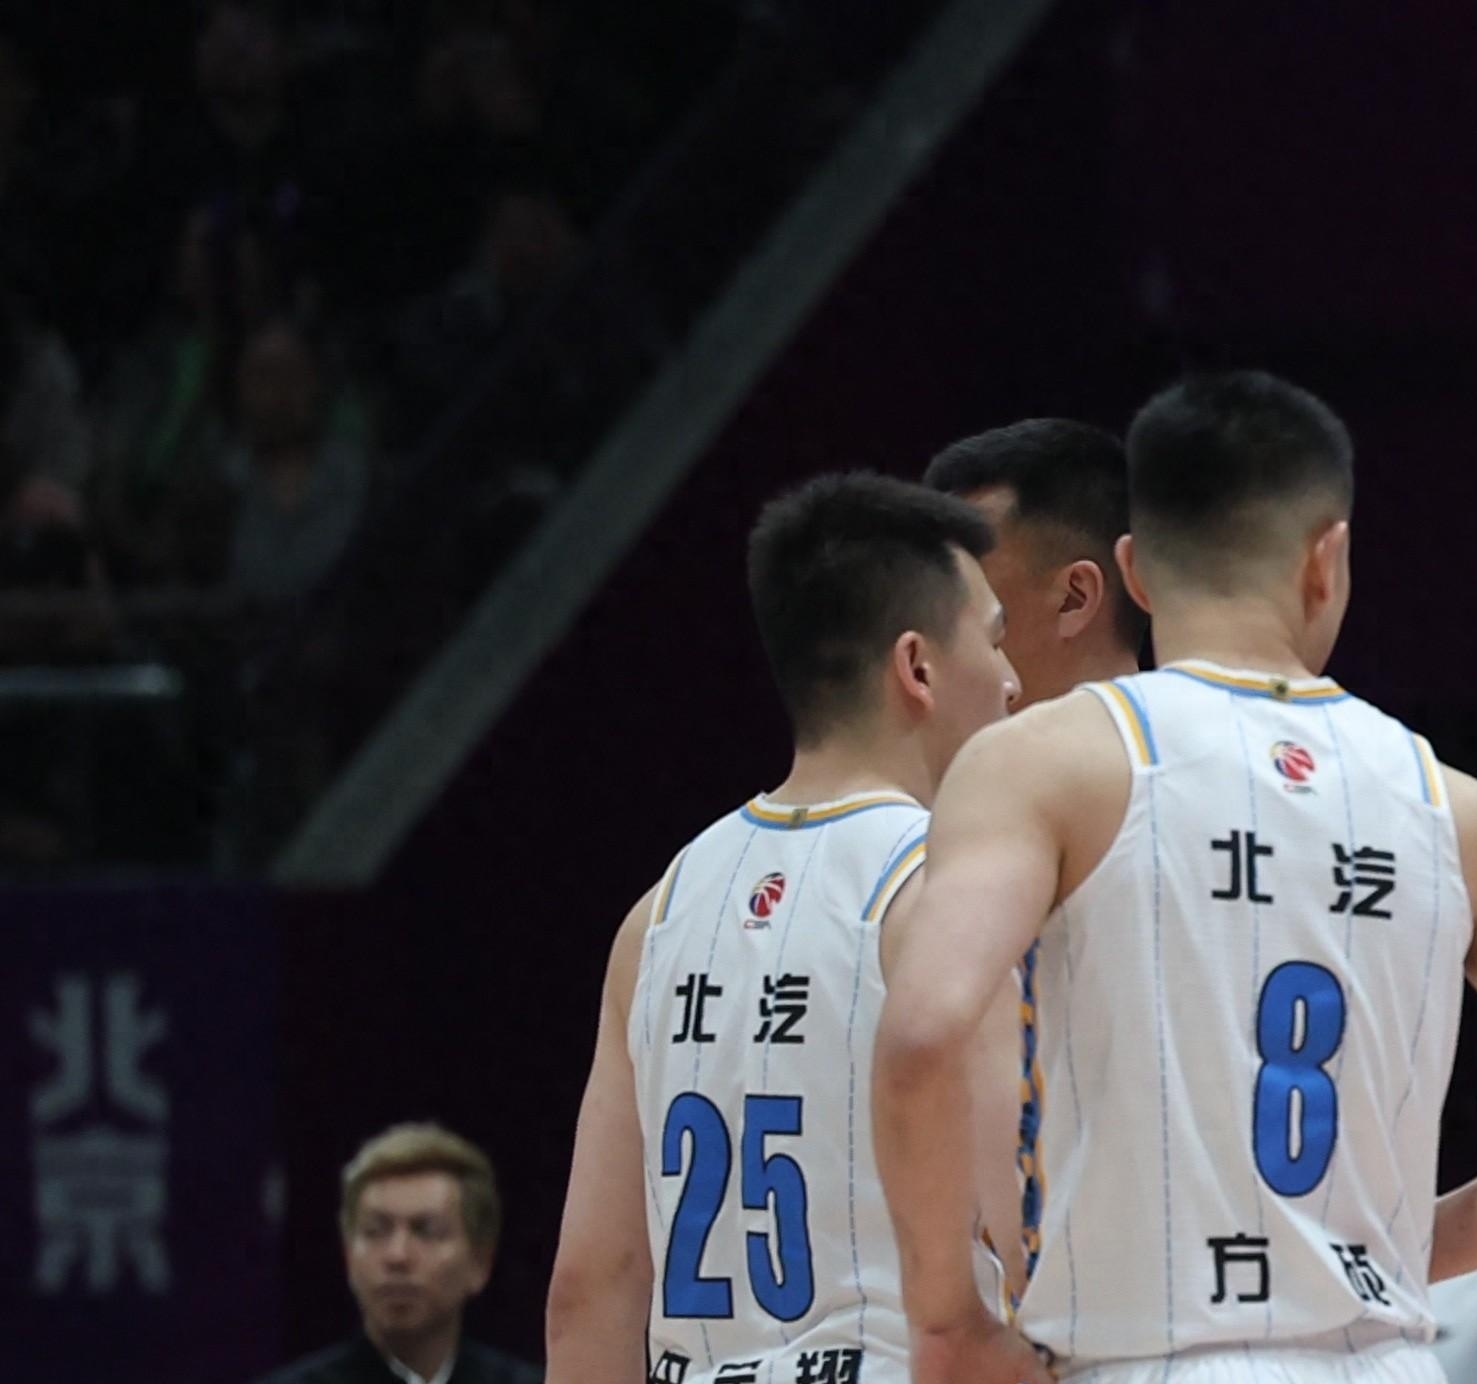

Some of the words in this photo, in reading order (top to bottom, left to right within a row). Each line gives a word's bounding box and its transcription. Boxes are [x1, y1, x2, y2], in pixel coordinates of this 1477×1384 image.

[1210, 830, 1396, 919] 北汽
[672, 973, 810, 1045] 北汽
[1253, 961, 1346, 1197] 8
[28, 970, 172, 1293] 北京
[662, 1091, 815, 1322] 25
